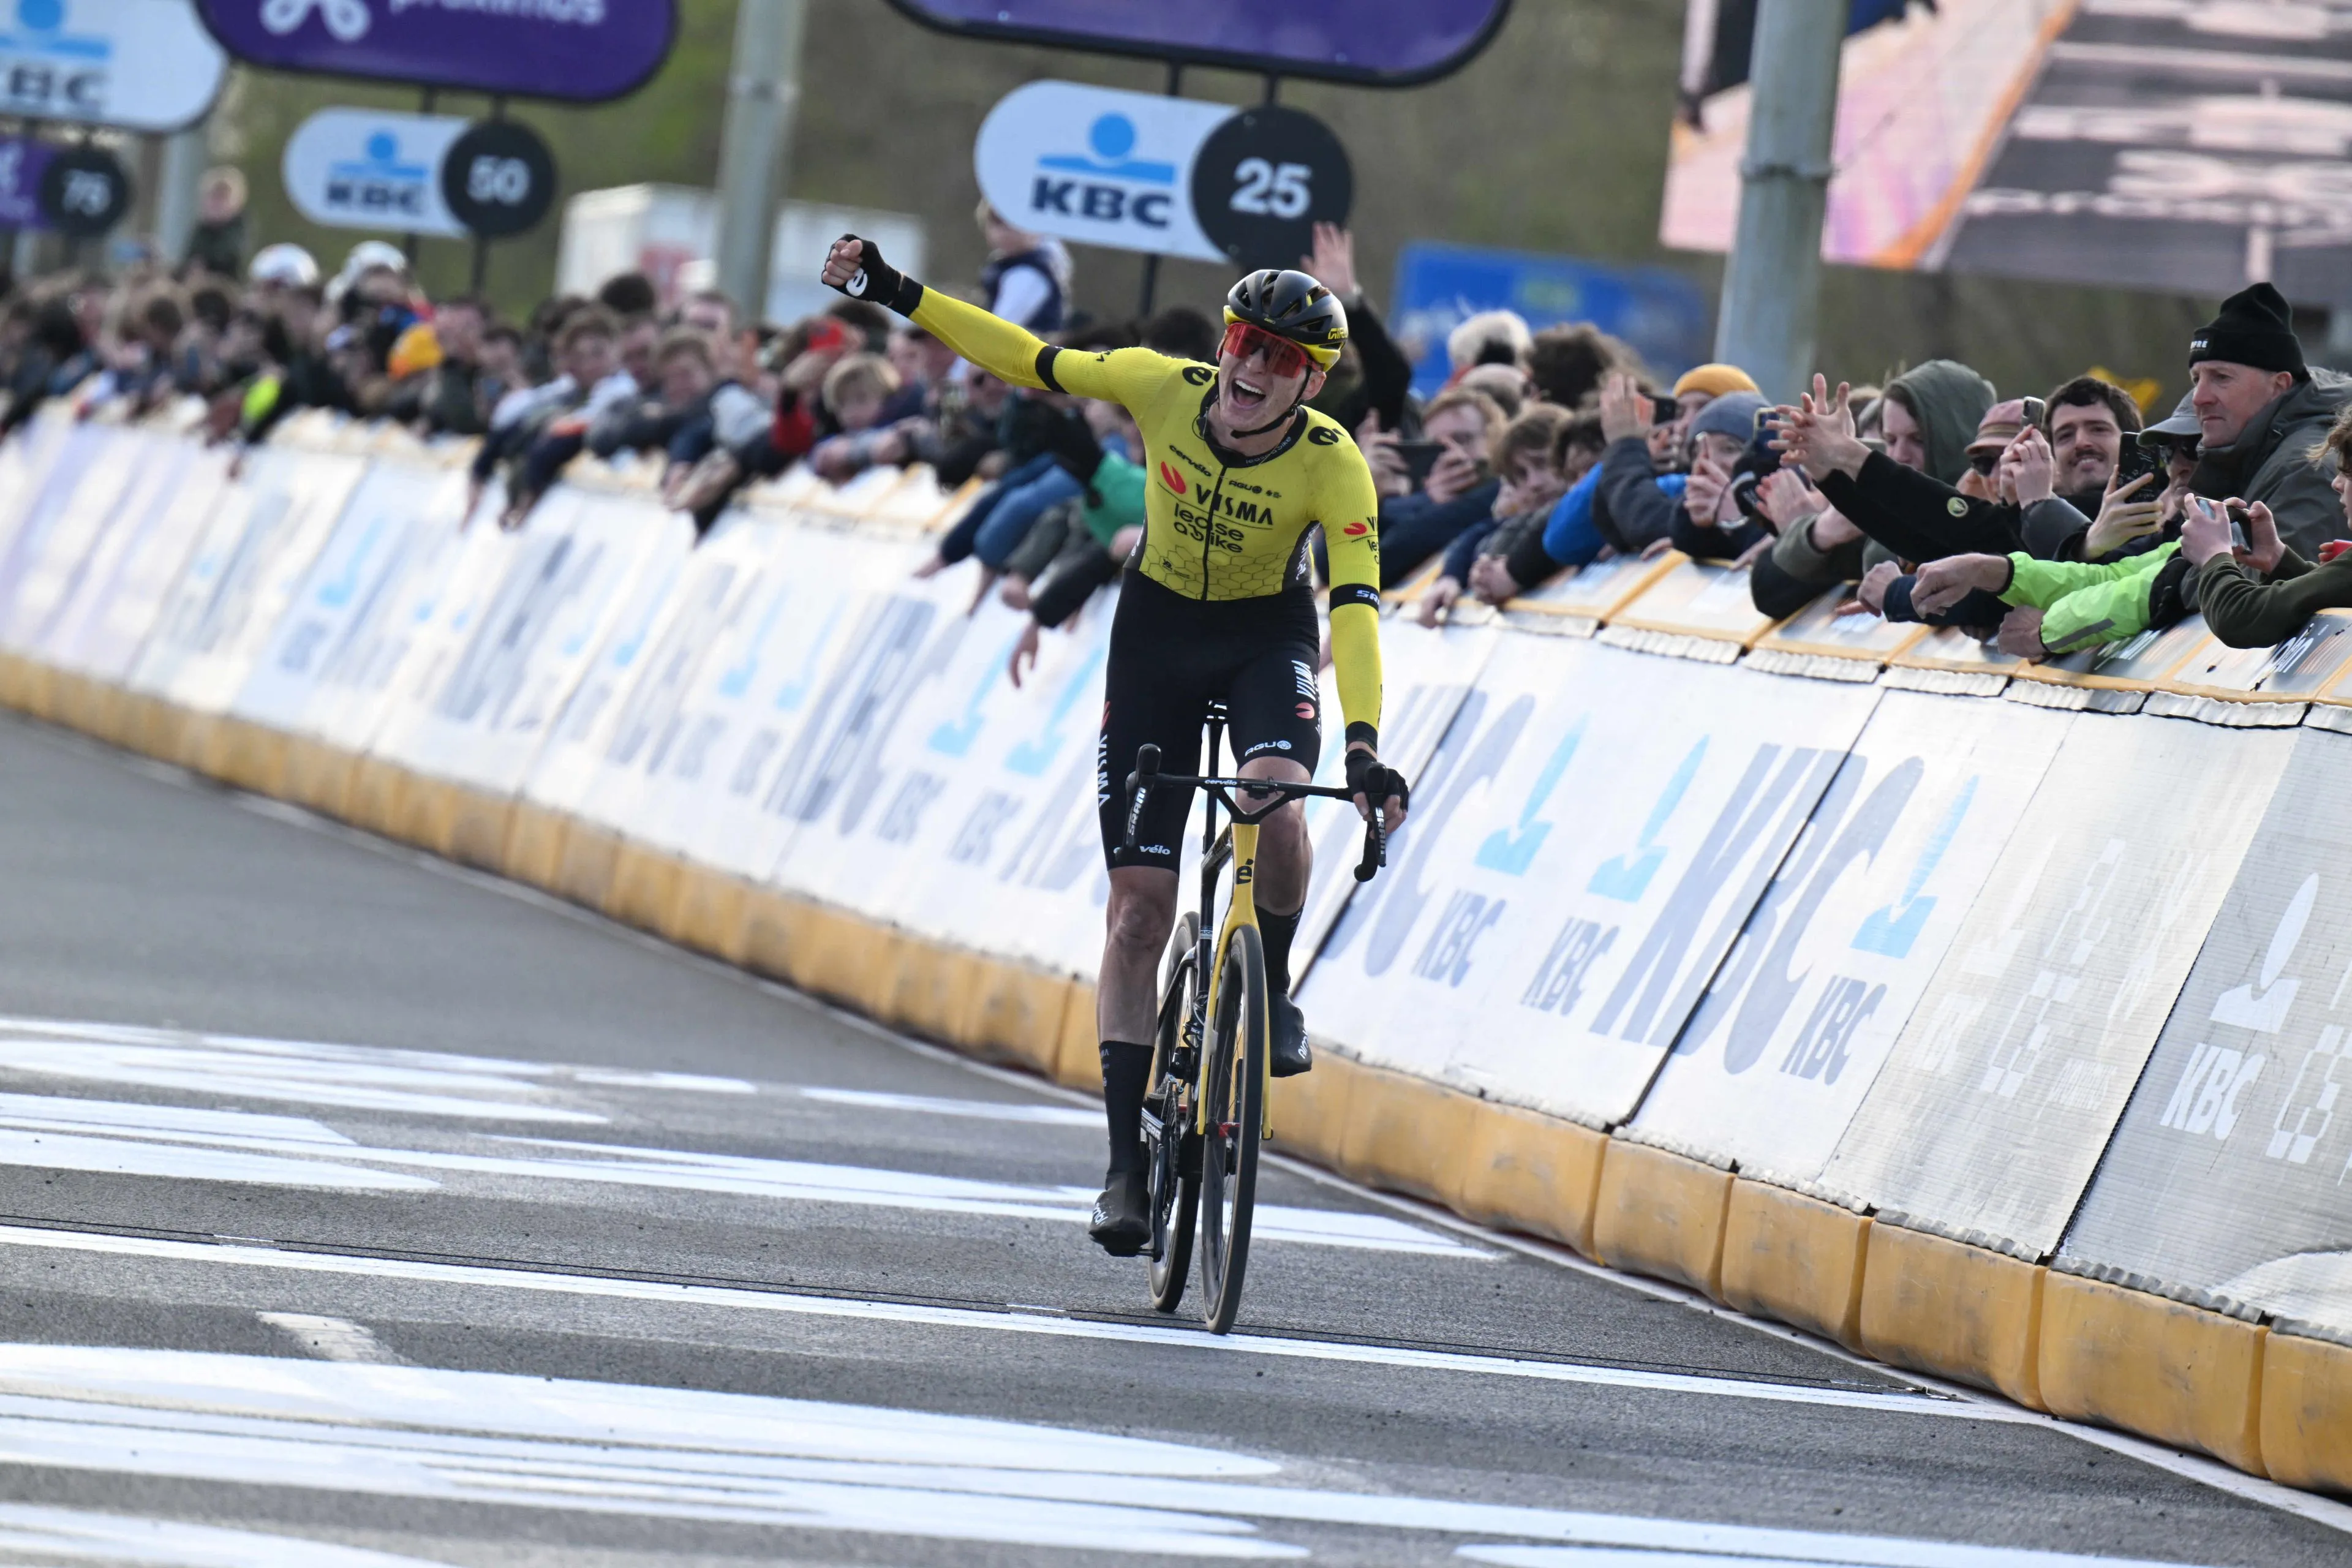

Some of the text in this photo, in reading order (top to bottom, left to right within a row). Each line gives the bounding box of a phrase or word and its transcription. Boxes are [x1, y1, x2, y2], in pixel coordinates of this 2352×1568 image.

[467, 154, 532, 206] 50
[1030, 176, 1174, 228] KBC
[1228, 157, 1313, 220] 25
[1174, 502, 1245, 541] lease
[1196, 483, 1274, 526] VISMA
[1244, 741, 1277, 757] AGU
[1127, 786, 1147, 836] SRAM
[1375, 807, 1386, 855] SRAM
[1589, 742, 1925, 1075] KBC
[1411, 888, 1507, 989] KBC
[1519, 916, 1621, 1017] KBC
[1779, 974, 1888, 1086] KBC
[2160, 1042, 2266, 1141] KBC
